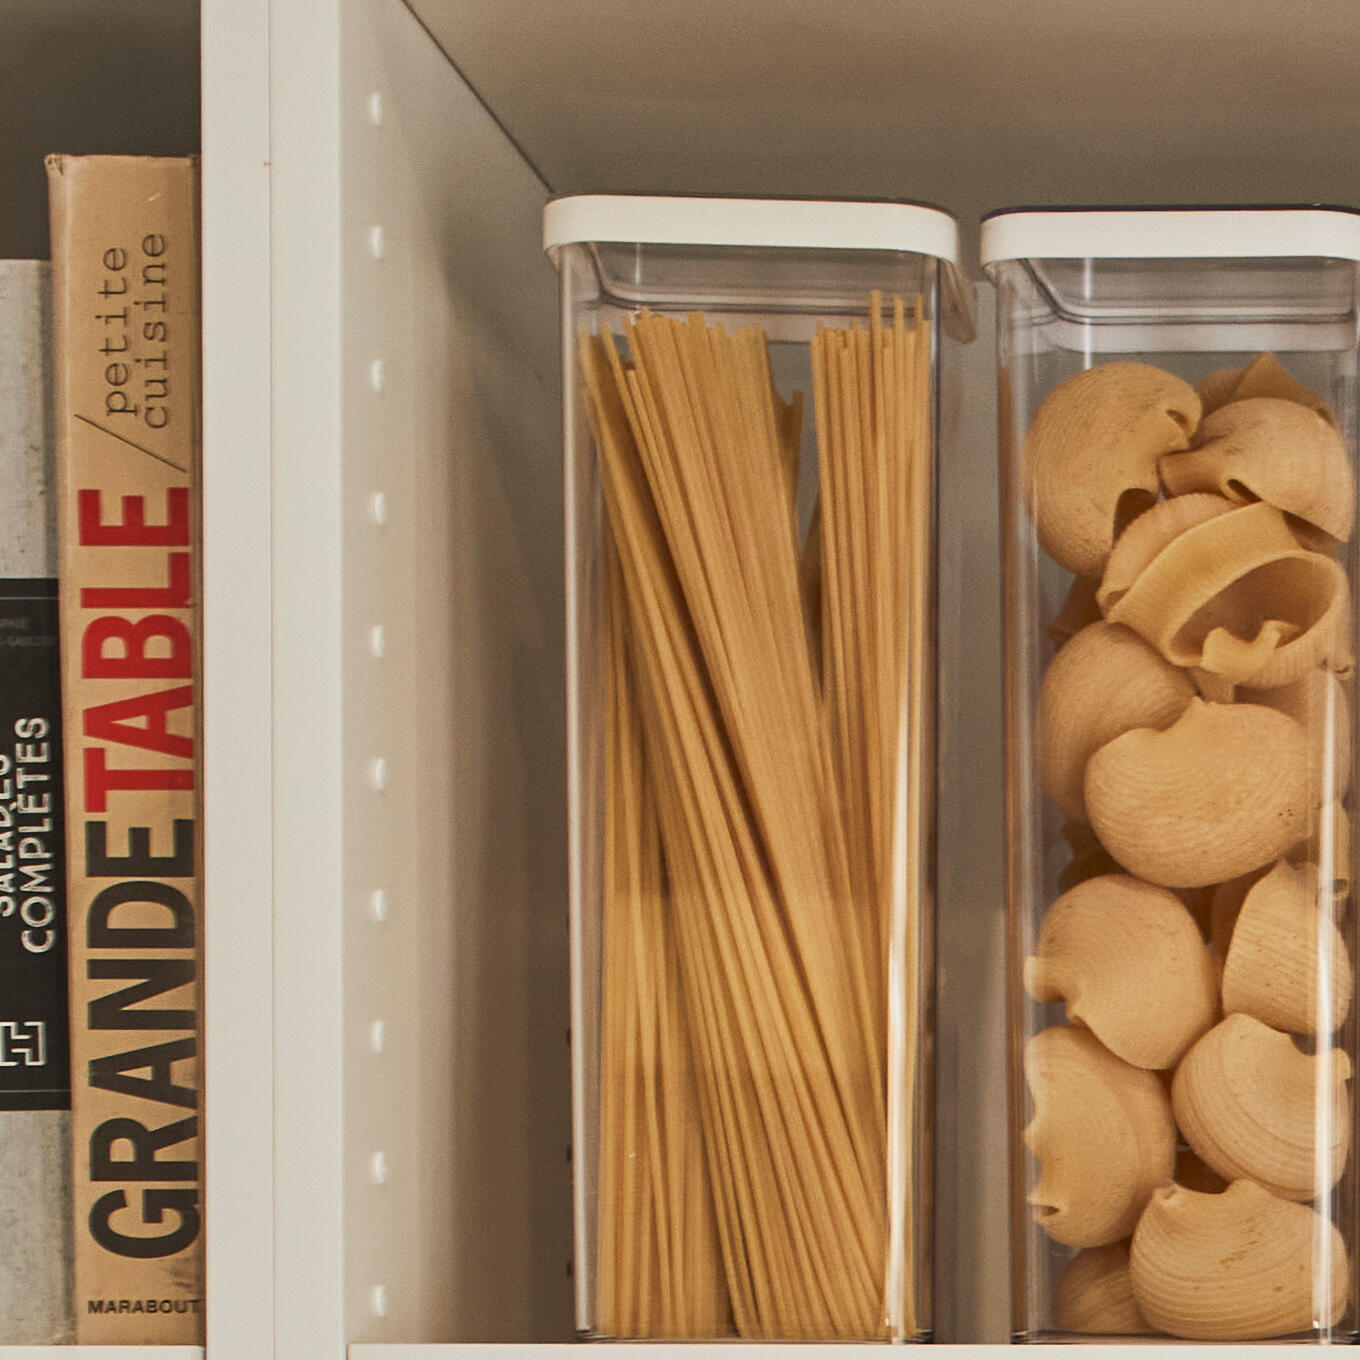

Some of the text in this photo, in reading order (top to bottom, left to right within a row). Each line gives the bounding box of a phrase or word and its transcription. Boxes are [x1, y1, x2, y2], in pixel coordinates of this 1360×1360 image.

[94, 247, 138, 417] petite
[133, 234, 169, 429] cuisine
[9, 717, 55, 953] COMPLÈTES
[87, 1299, 202, 1314] MARABOUT
